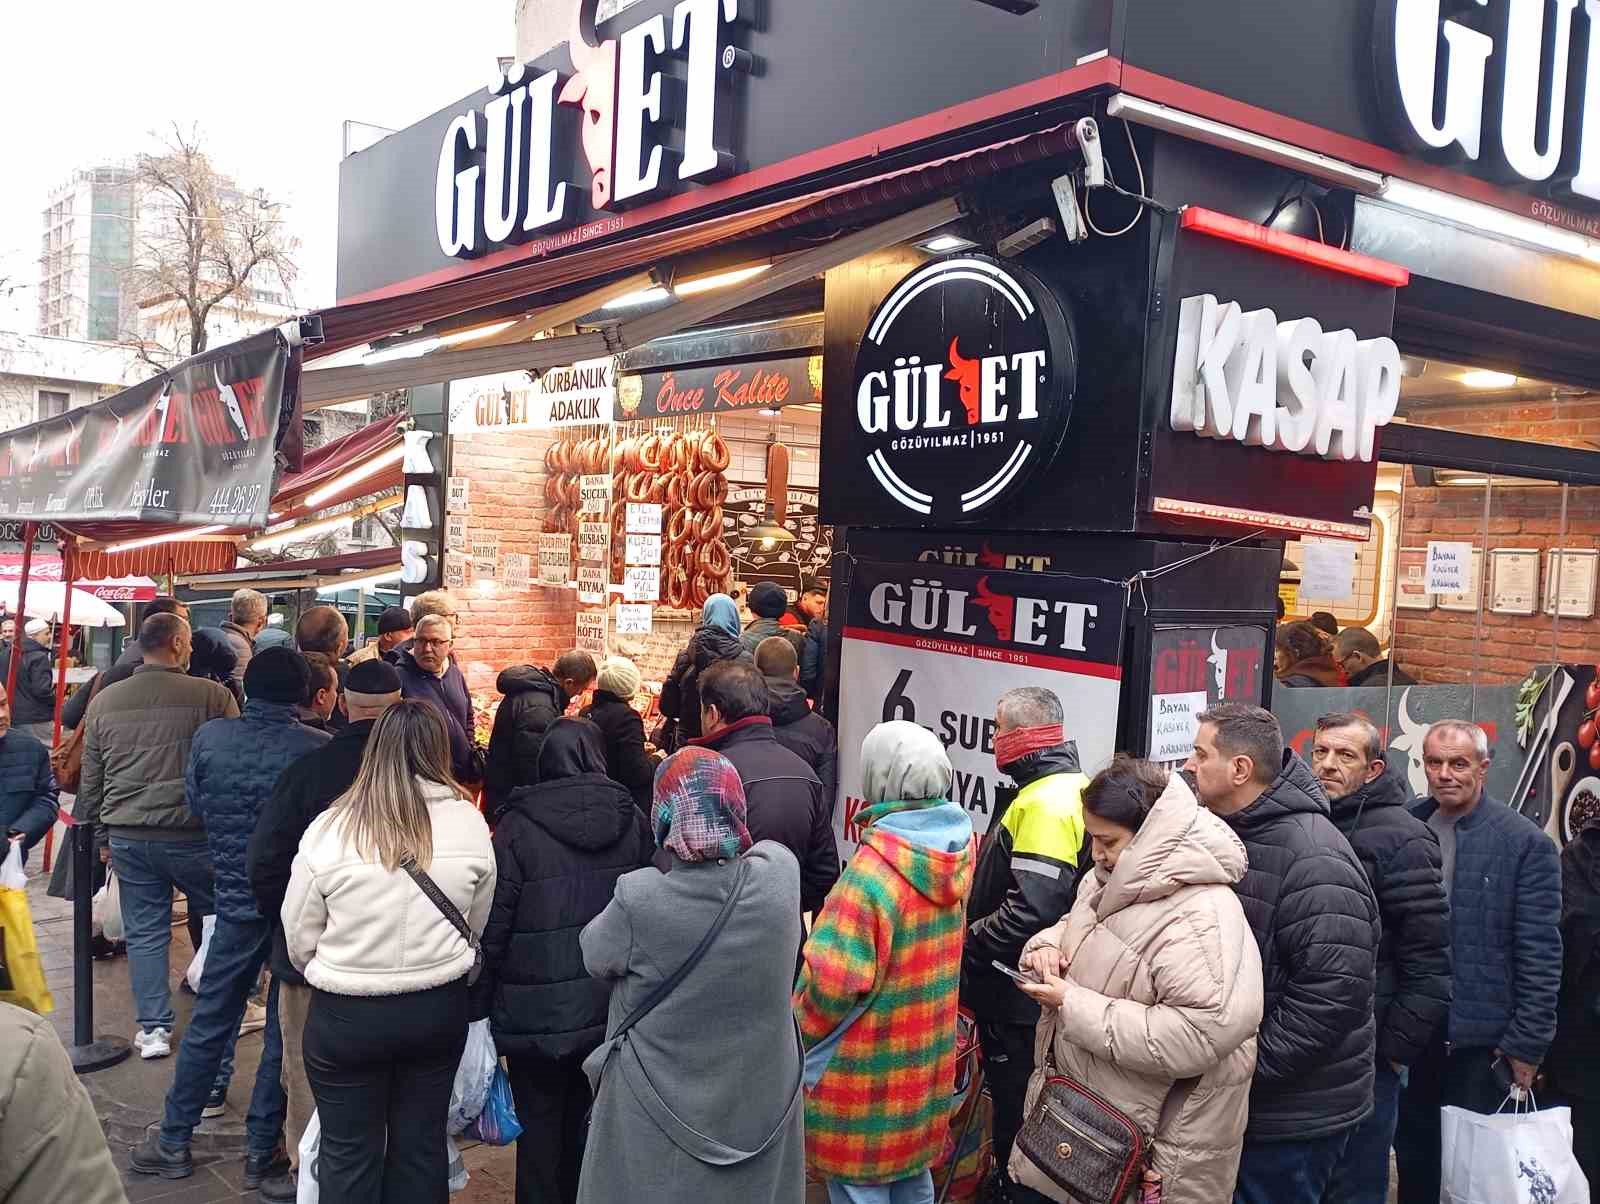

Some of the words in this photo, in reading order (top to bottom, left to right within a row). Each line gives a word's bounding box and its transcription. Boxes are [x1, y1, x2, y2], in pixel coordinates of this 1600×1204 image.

[582, 223, 603, 239] SINCE
[607, 217, 624, 232] 1951
[540, 366, 608, 393] KURBANLIK
[656, 372, 704, 413] Önce
[713, 369, 790, 408] Kalite
[1171, 293, 1401, 463] KASAP
[549, 397, 600, 422] ADAKLIK
[891, 434, 968, 450] GÖZÜYILMAZ
[977, 432, 1004, 444] 1951
[581, 489, 608, 500] SUCUK
[401, 430, 434, 611] KAS
[578, 581, 605, 594] KIYMA
[869, 579, 977, 636] GÜL
[977, 648, 1004, 660] SINCE
[1008, 653, 1029, 664] 1951
[938, 710, 998, 756] ŞUB
[945, 768, 989, 815] YA
